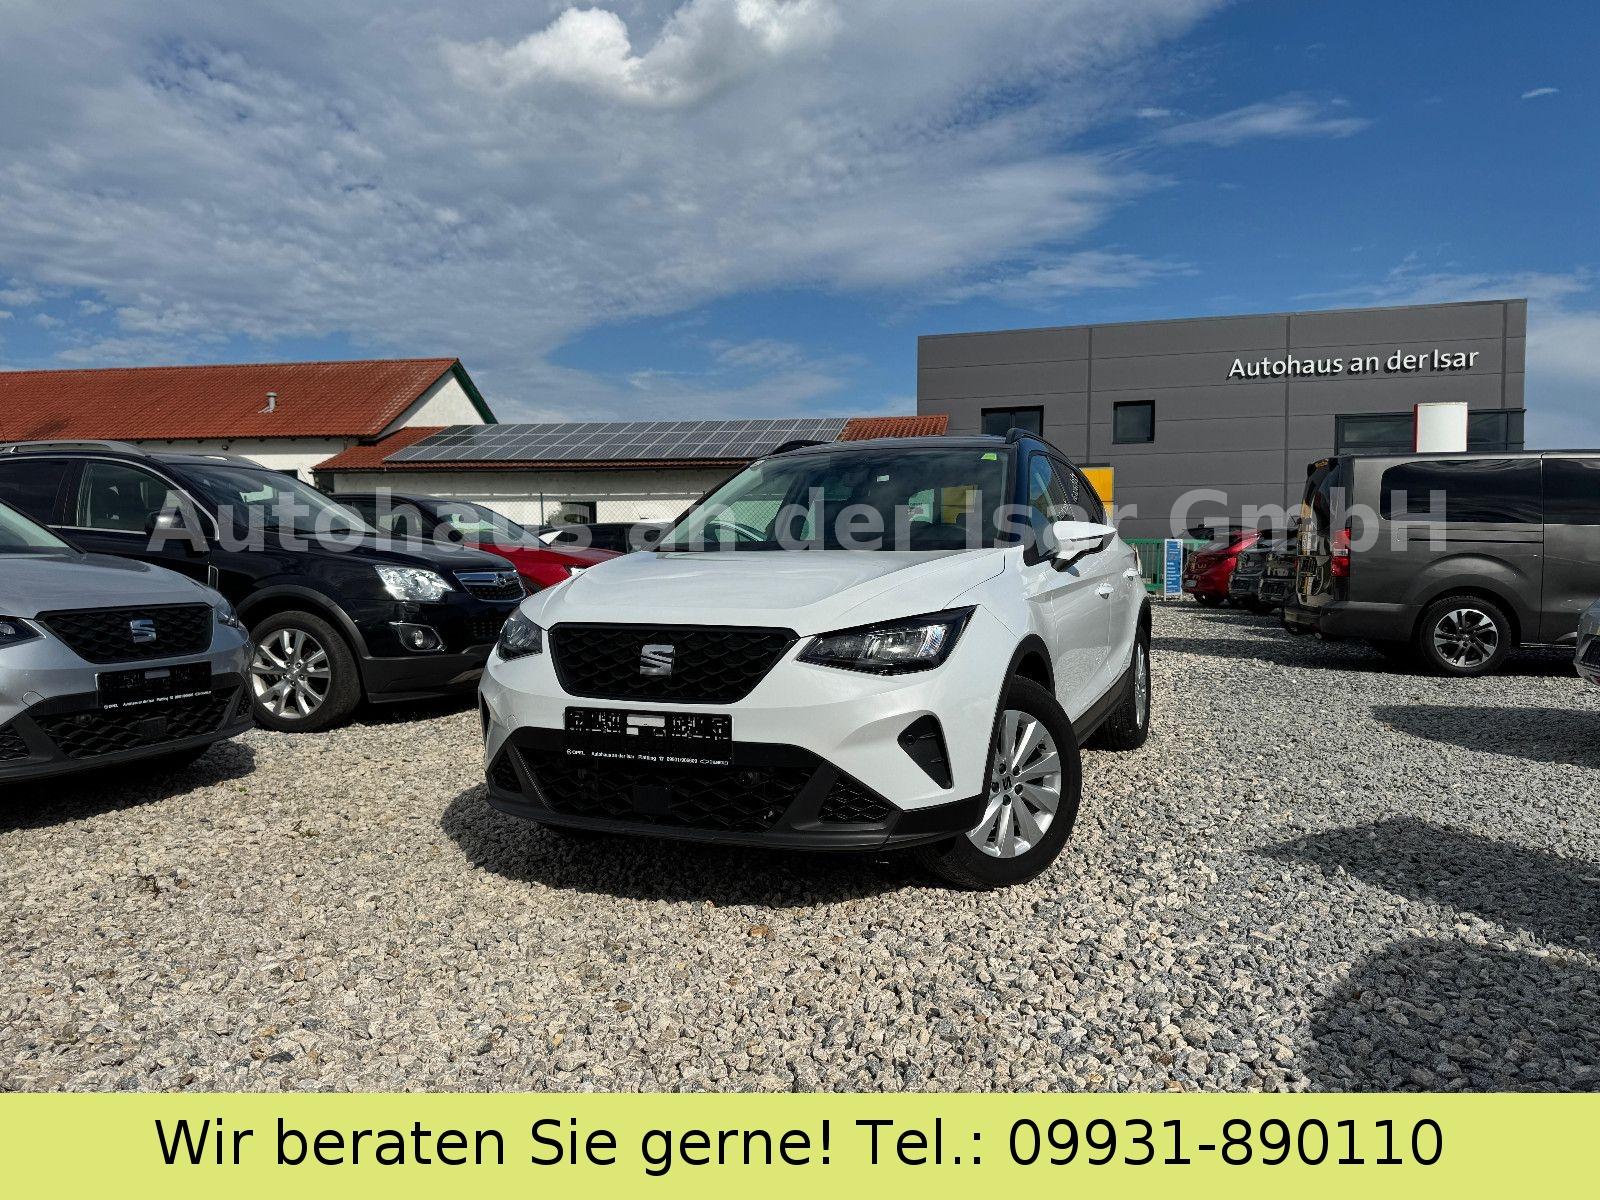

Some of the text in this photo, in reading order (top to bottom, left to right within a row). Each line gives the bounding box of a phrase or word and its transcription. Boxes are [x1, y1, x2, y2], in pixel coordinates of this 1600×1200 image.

[1228, 349, 1480, 377] Autohaus an der Isar
